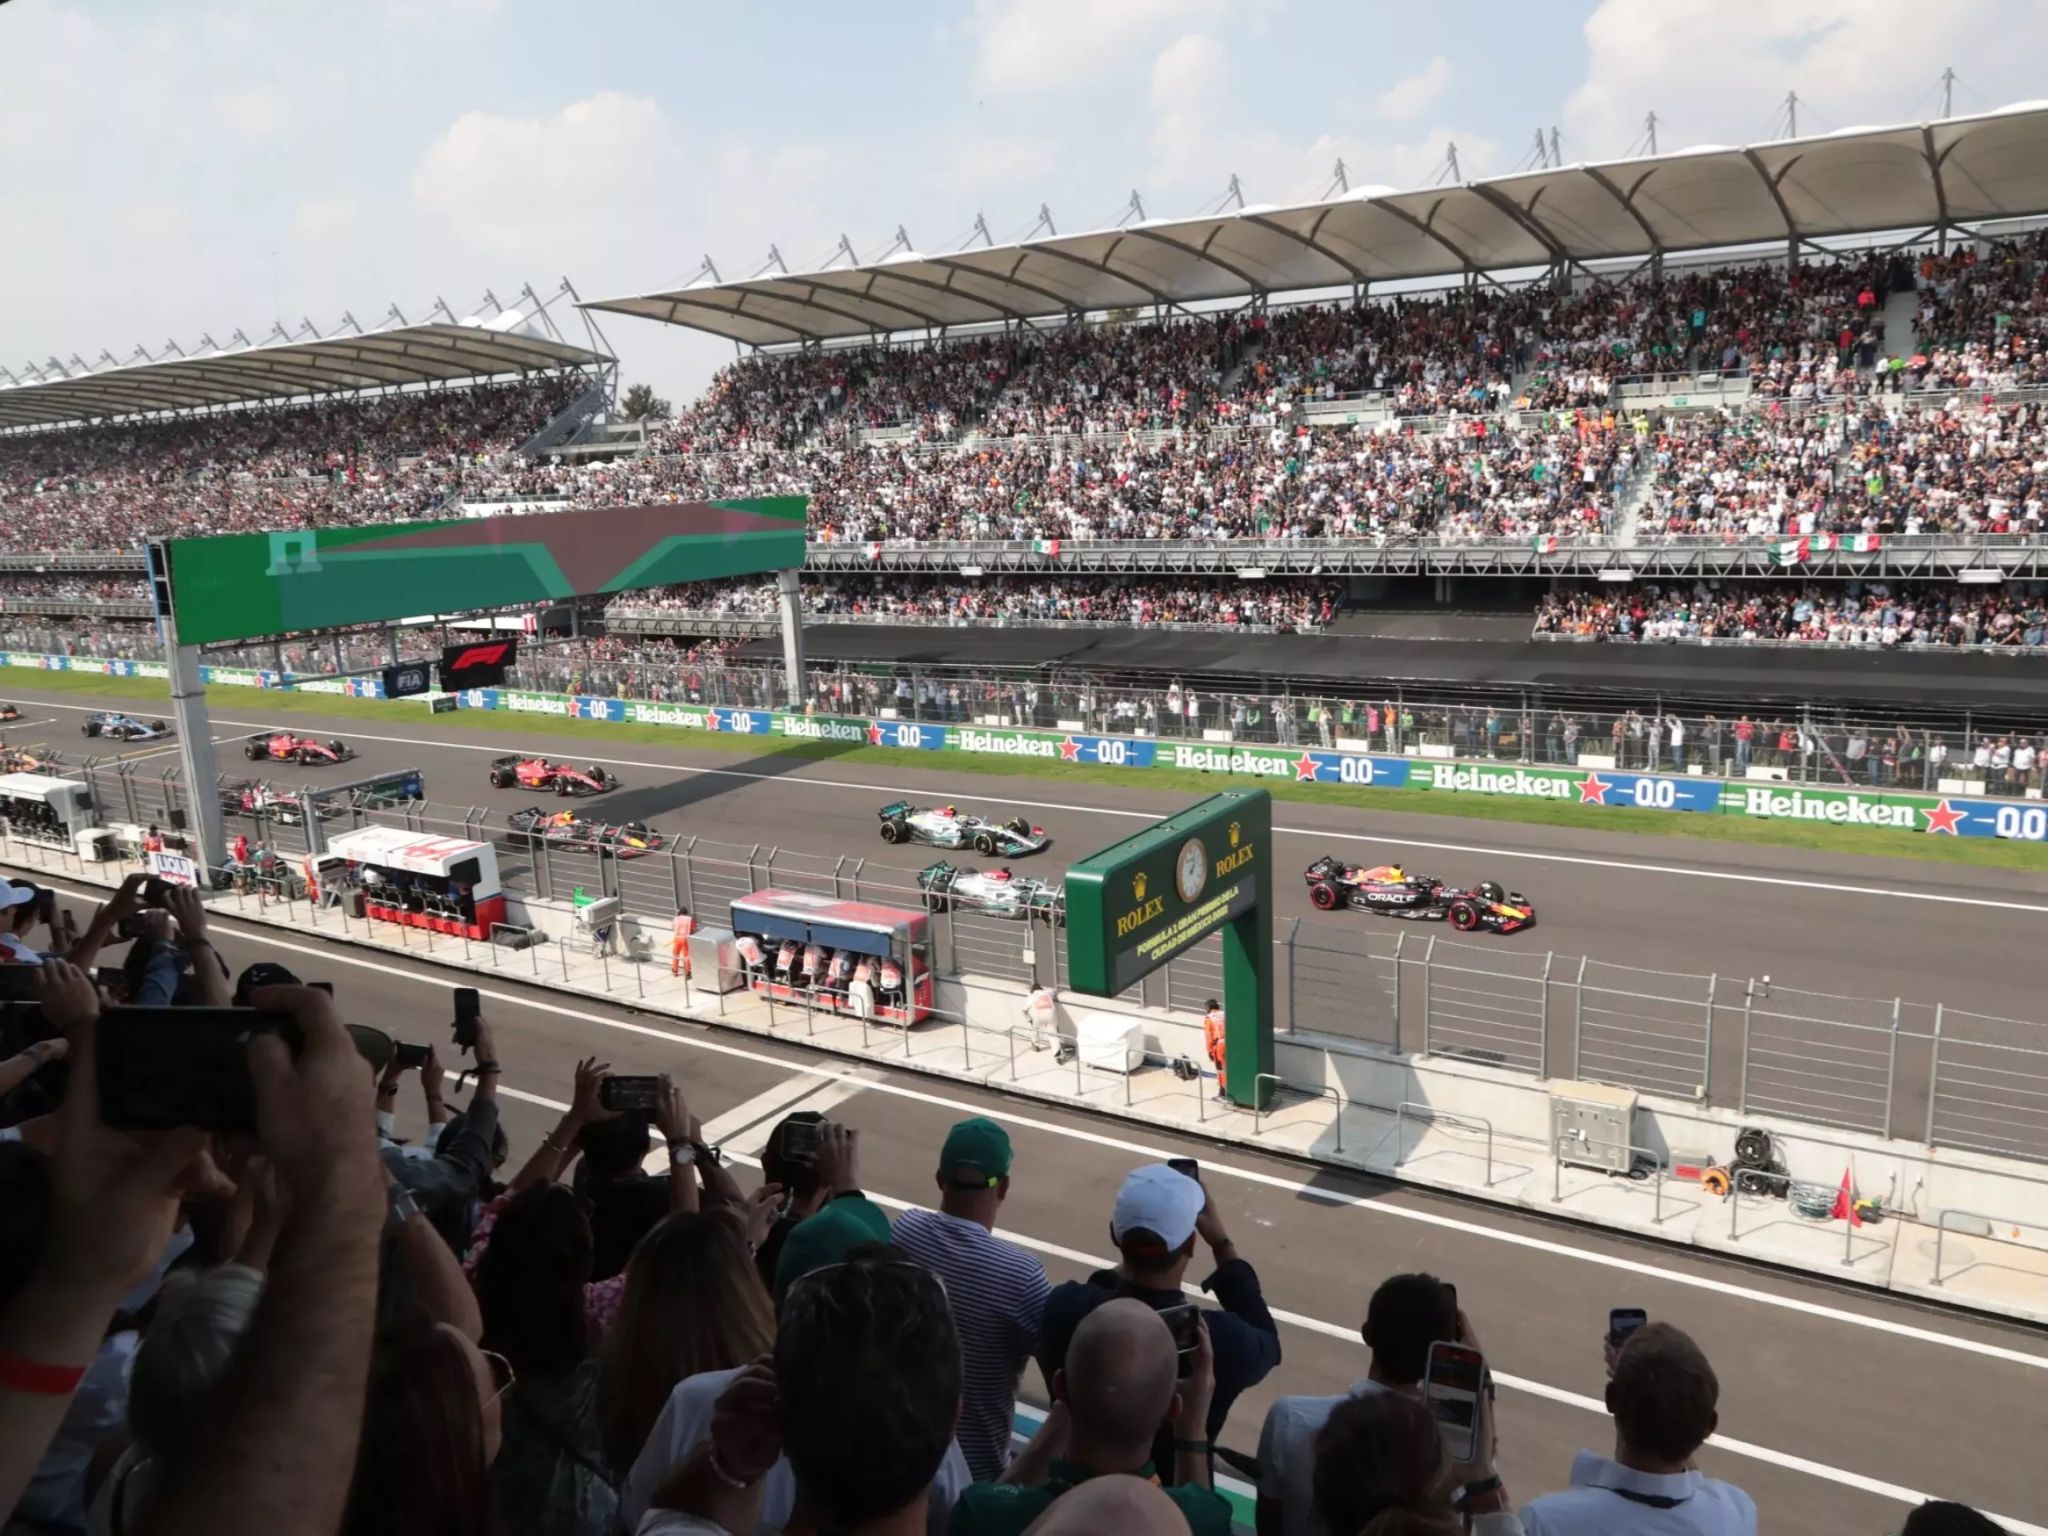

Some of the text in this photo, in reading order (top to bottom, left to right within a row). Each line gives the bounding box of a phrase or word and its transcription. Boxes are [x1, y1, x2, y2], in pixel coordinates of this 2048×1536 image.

[397, 672, 421, 689] FIA
[508, 694, 567, 714] Heineken
[635, 704, 752, 733] Heineken 0.0
[783, 716, 921, 747] Heineken 0.0
[959, 730, 1126, 764] Heineken 0.0
[1174, 746, 1373, 784] Heineken 0.0
[1432, 764, 1676, 808] Heineken 0.0
[1745, 788, 2047, 840] Heineken 0.0
[1216, 843, 1255, 879] ROLEX
[1367, 892, 1417, 904] ORACLE
[1116, 895, 1165, 938] ROLEX
